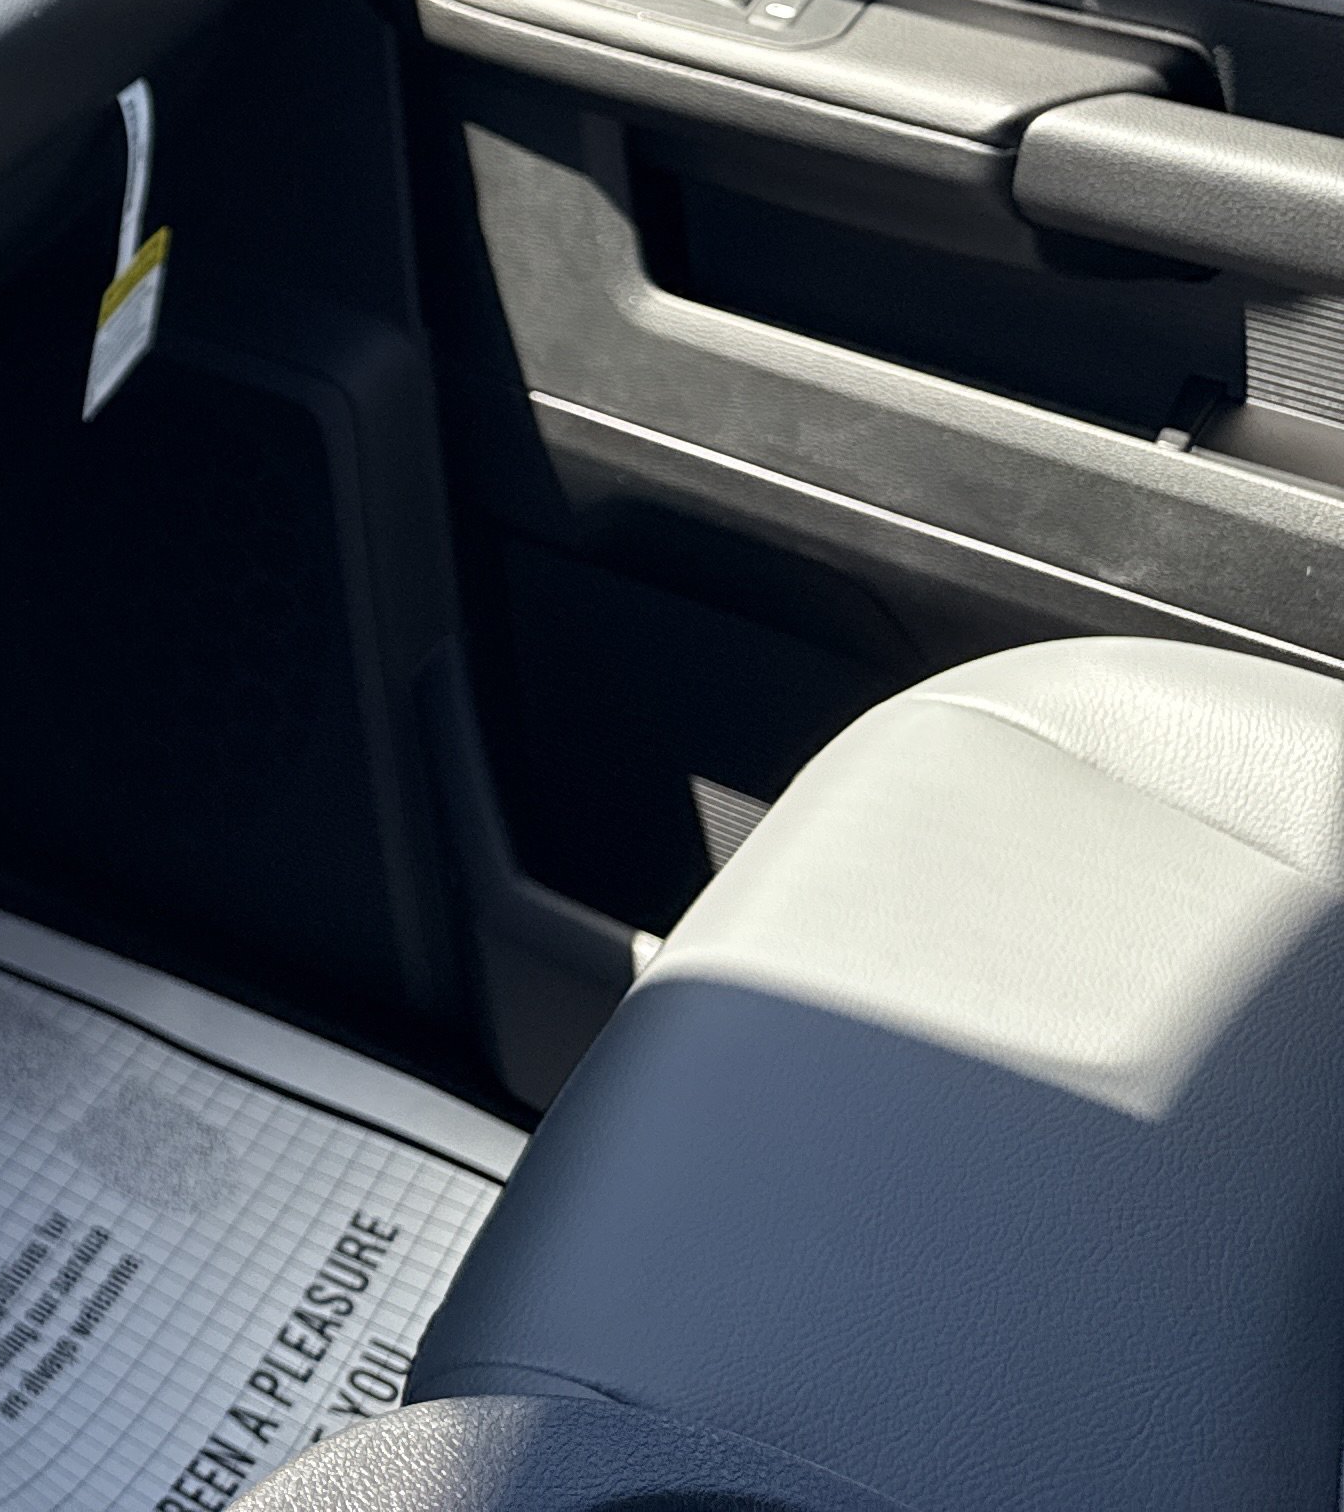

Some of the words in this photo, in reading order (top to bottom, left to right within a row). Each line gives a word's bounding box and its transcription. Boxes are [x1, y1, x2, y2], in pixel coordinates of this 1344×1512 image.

[24, 1289, 61, 1327] our
[50, 1224, 113, 1296] service
[248, 1207, 401, 1408] PLEASURE
[19, 1335, 82, 1397] always
[330, 1336, 416, 1419] YOU
[226, 1405, 280, 1445] A
